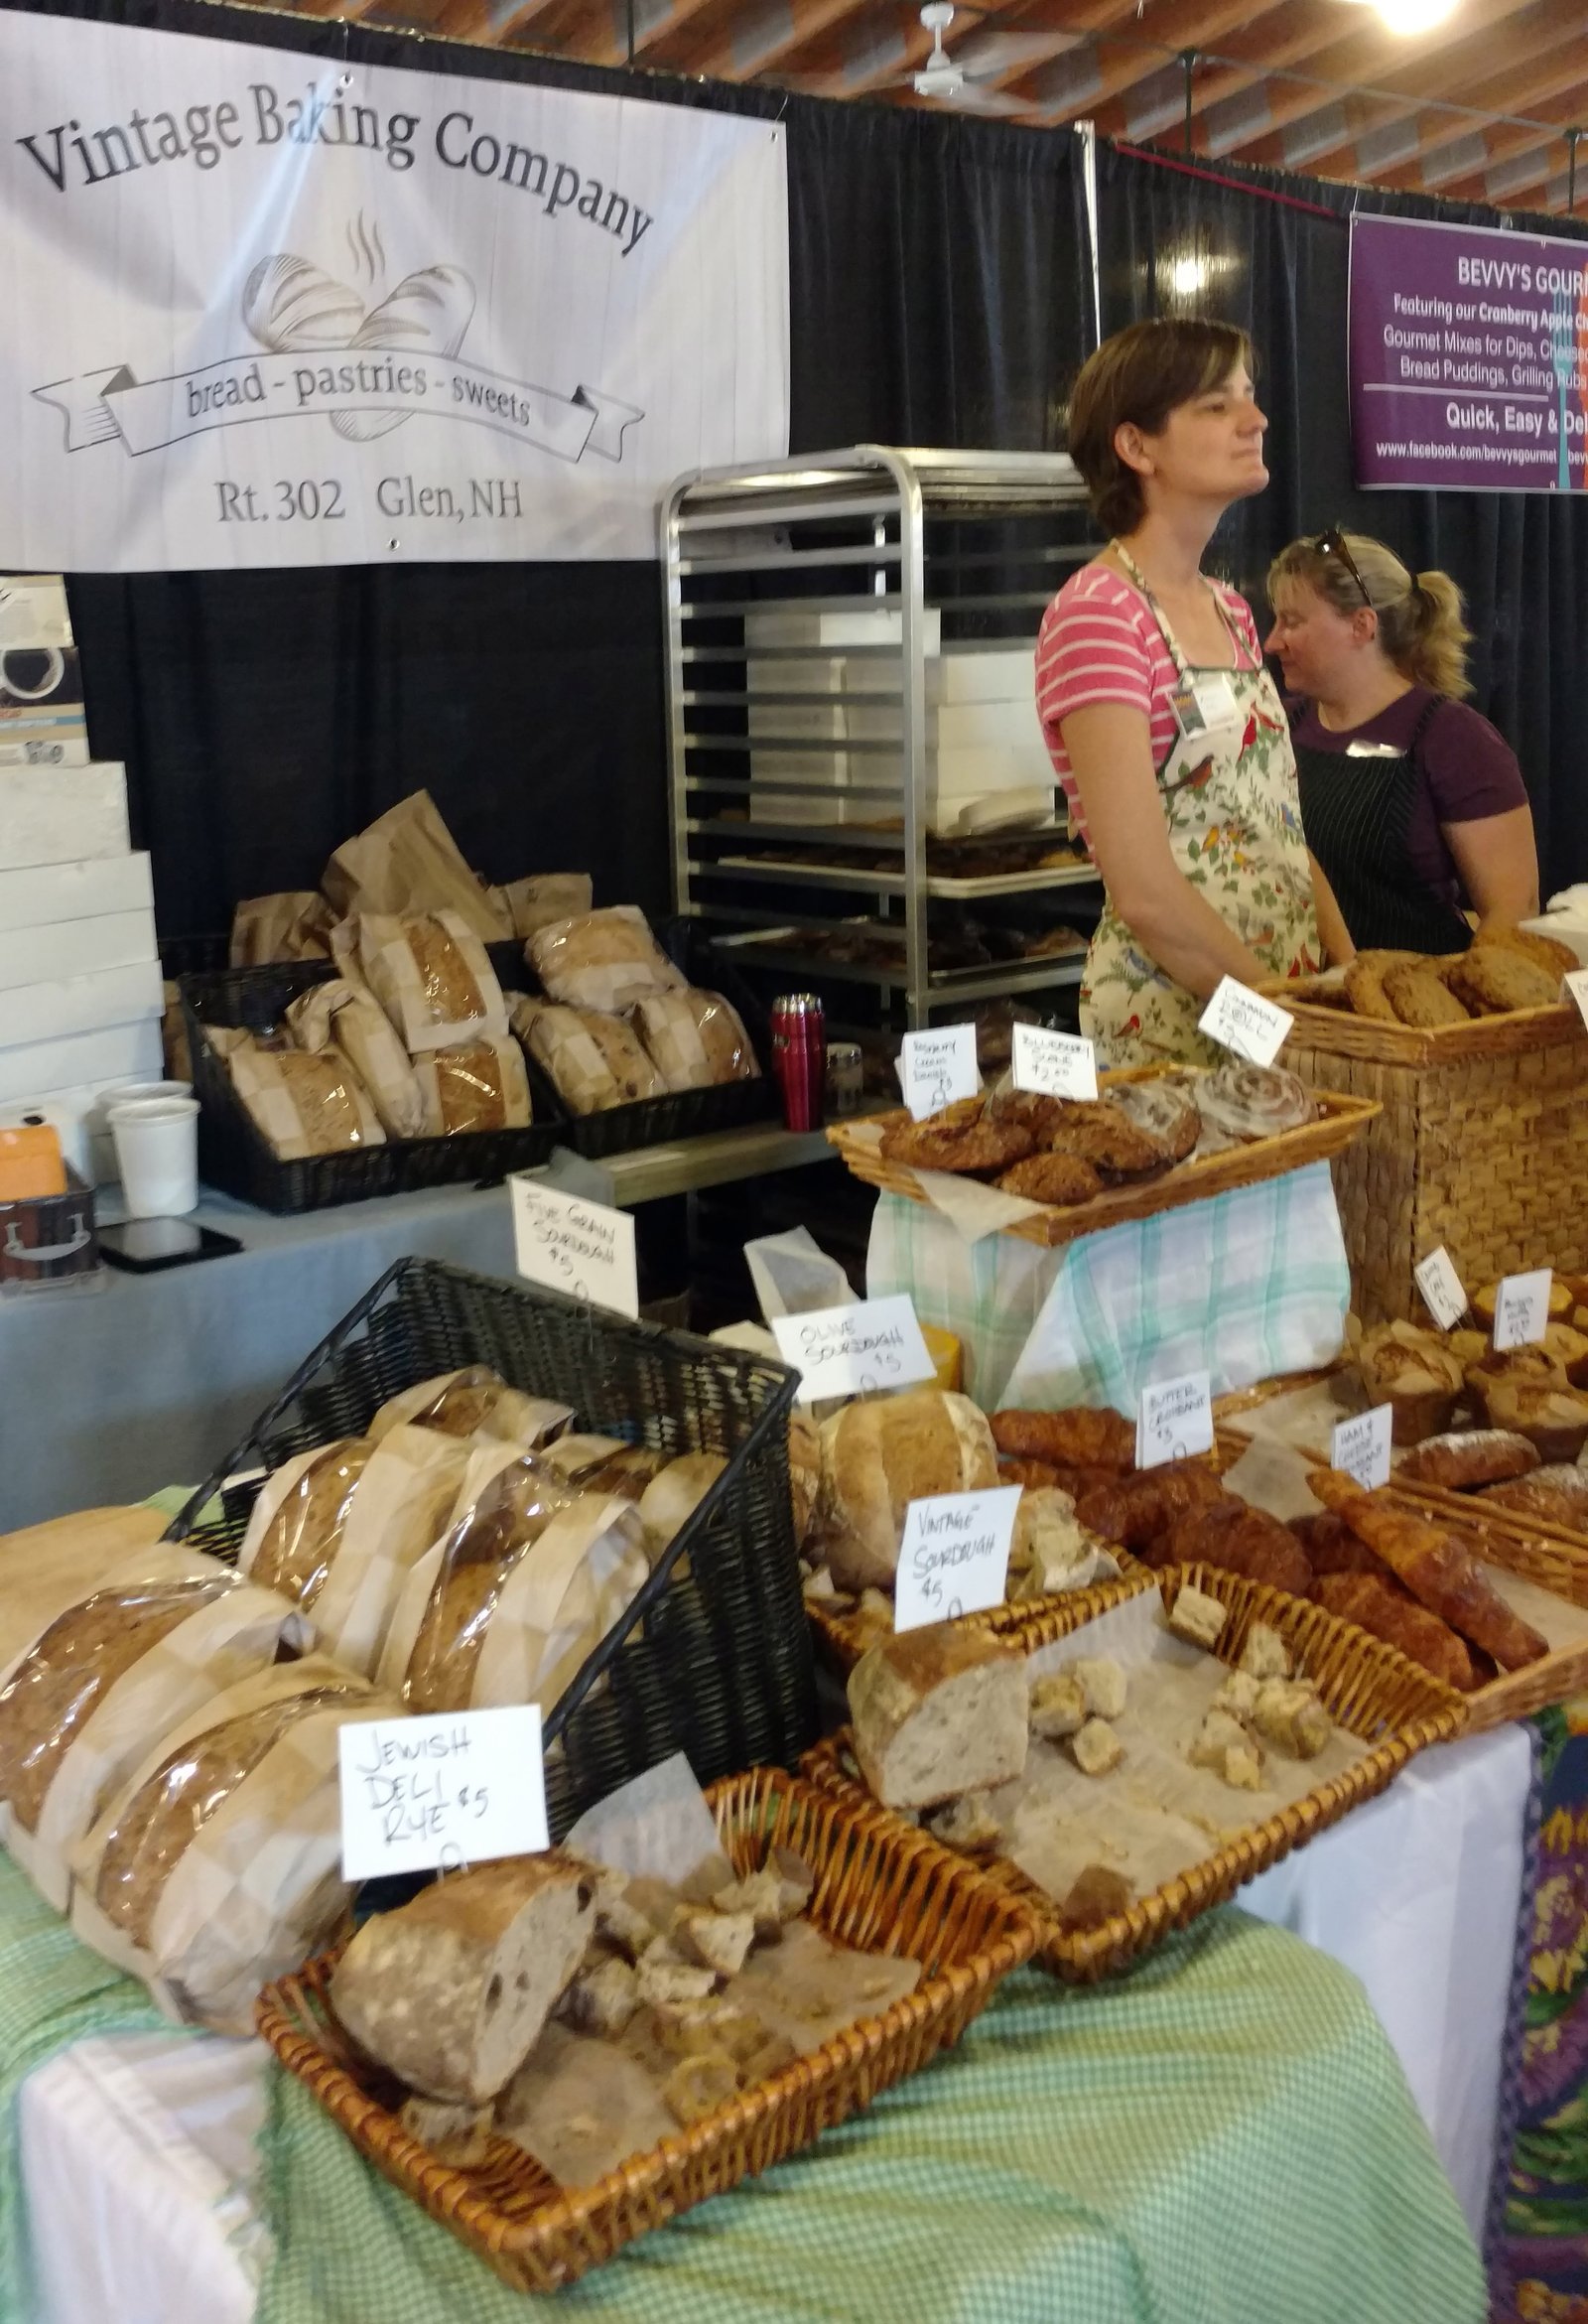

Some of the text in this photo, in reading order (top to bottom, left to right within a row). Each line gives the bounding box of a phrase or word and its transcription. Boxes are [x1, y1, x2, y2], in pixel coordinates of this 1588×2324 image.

[16, 81, 654, 257] Vintage Baking Company
[1458, 255, 1531, 293] BEVVY'S
[1393, 292, 1453, 326] Featuring
[1456, 302, 1477, 321] our
[1479, 301, 1537, 334] Cranberry
[1540, 308, 1573, 334] Apple
[1384, 324, 1440, 351] Gourmet
[1444, 330, 1482, 354] Mixes
[1486, 334, 1503, 357] for
[1507, 336, 1536, 362] Dips,
[186, 362, 267, 419] bread
[294, 356, 427, 407] pastries
[452, 374, 531, 428] sweets
[1400, 354, 1439, 380] Bread
[1444, 358, 1509, 389] Puddings,
[1512, 363, 1554, 393] Grilling
[1445, 402, 1500, 434] Quick,
[1505, 405, 1543, 439] Easy
[1548, 408, 1558, 434] &
[918, 1502, 981, 1538] VINTAGE
[912, 1532, 995, 1579] SOURDOUGH
[355, 1724, 471, 1774] JEWISH
[363, 1768, 445, 1810] DELI
[382, 1784, 490, 1846] RYE $5
